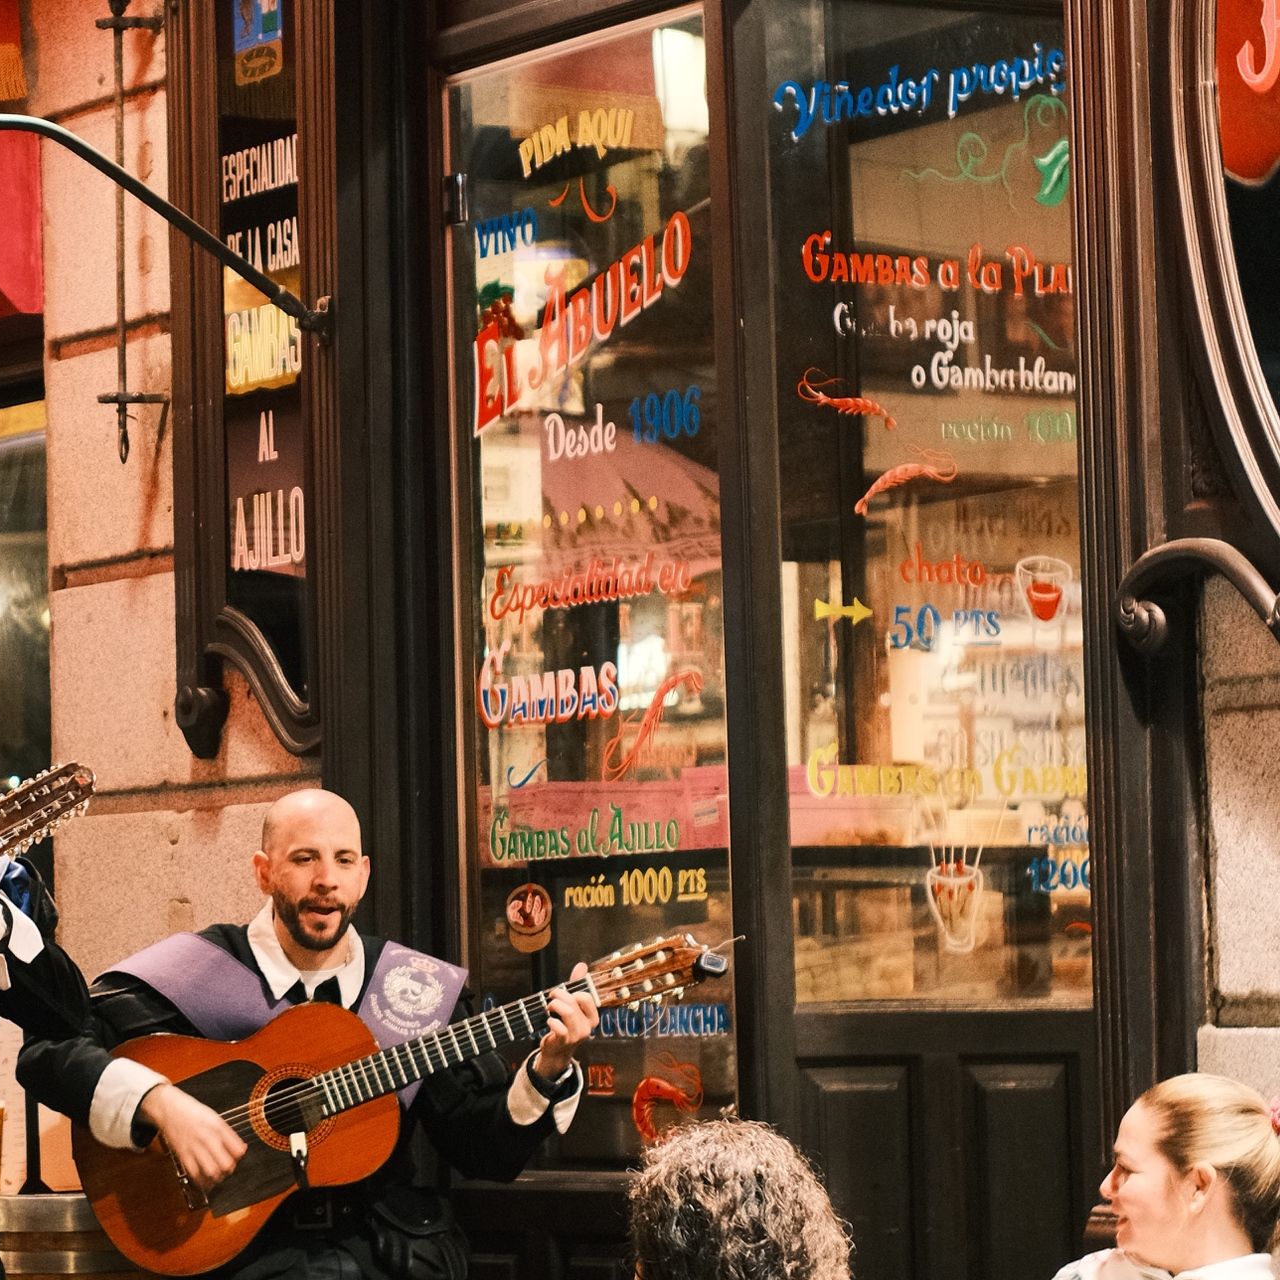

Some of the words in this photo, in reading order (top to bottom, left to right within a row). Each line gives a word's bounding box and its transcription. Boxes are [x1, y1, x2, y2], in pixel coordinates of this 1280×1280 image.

[519, 115, 571, 179] PIDA
[576, 107, 634, 160] AQUI
[267, 216, 301, 272] CASA
[475, 206, 538, 259] VINO
[802, 230, 930, 289] GAMBAS
[938, 259, 960, 290] a
[967, 242, 1002, 293] la
[1005, 243, 1072, 296] PLA
[228, 303, 302, 387] GAMBAS
[473, 320, 521, 438] EL
[528, 210, 692, 390] ABUELO
[924, 309, 975, 350] roja
[911, 364, 926, 389] o
[931, 350, 1015, 392] Gamba
[1019, 355, 1076, 394] blan
[257, 410, 278, 464] AL
[544, 403, 617, 462] Desde
[629, 384, 701, 444] 1906
[234, 485, 305, 572] AJILLO
[489, 551, 654, 624] Especialidad
[658, 560, 692, 594] en
[900, 540, 985, 587] chato
[890, 602, 942, 651] 50
[953, 608, 1002, 640] PTS
[478, 639, 619, 729] GAMBAS
[808, 742, 938, 797] GAMBAS
[489, 809, 571, 862] GAMBAS
[576, 808, 600, 857] al
[601, 801, 680, 857] AJILLO
[1027, 815, 1088, 845] ració
[564, 873, 616, 908] ración
[619, 866, 673, 905] 1000
[677, 867, 708, 894] PTS
